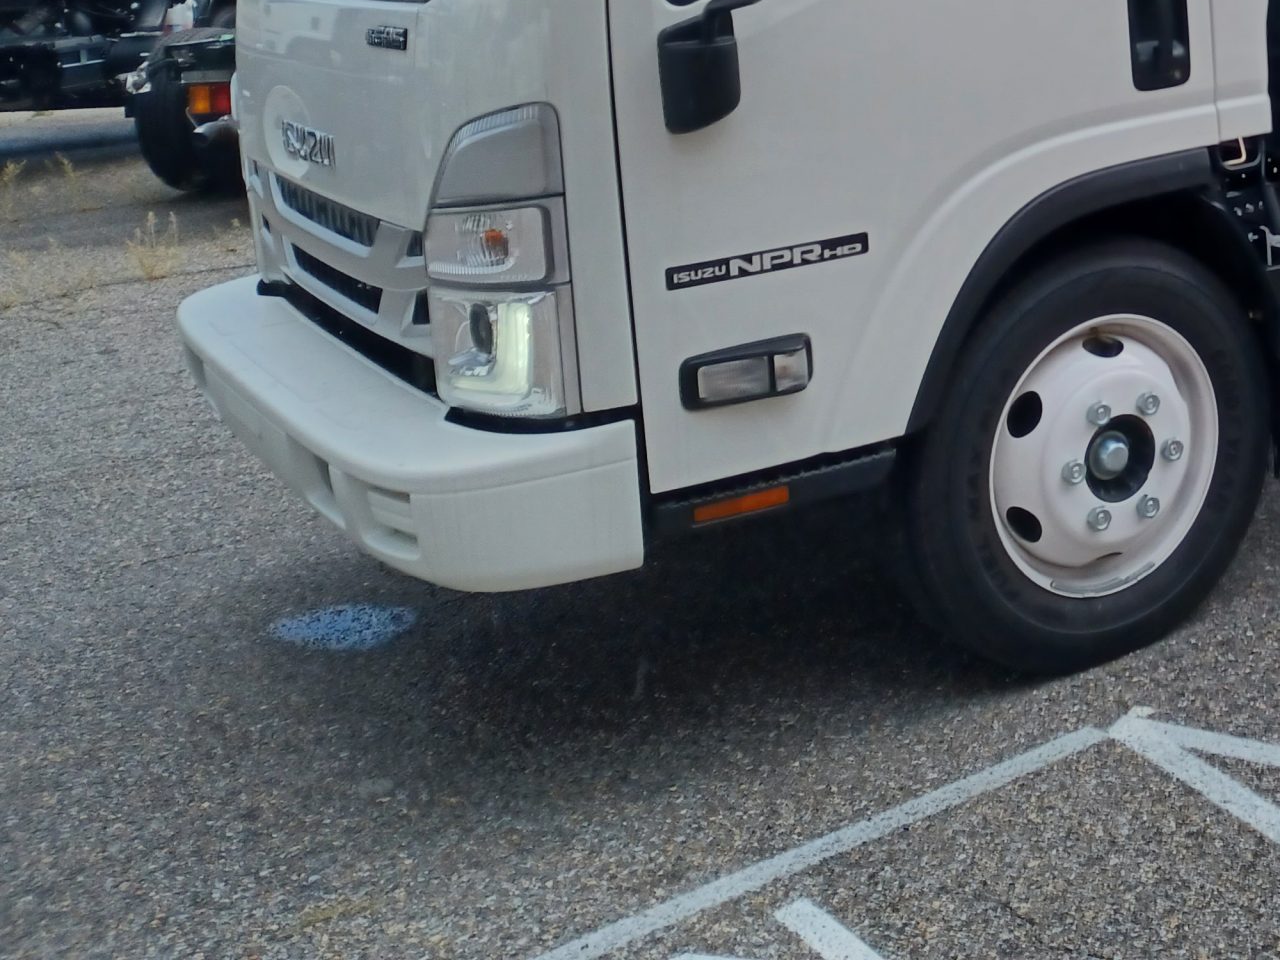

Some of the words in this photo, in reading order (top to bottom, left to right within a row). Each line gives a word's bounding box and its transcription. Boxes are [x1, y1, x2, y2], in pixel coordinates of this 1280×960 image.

[281, 119, 336, 168] ISUZU
[673, 264, 727, 284] ISUZU
[729, 243, 822, 277] NPR
[823, 243, 862, 259] HD
